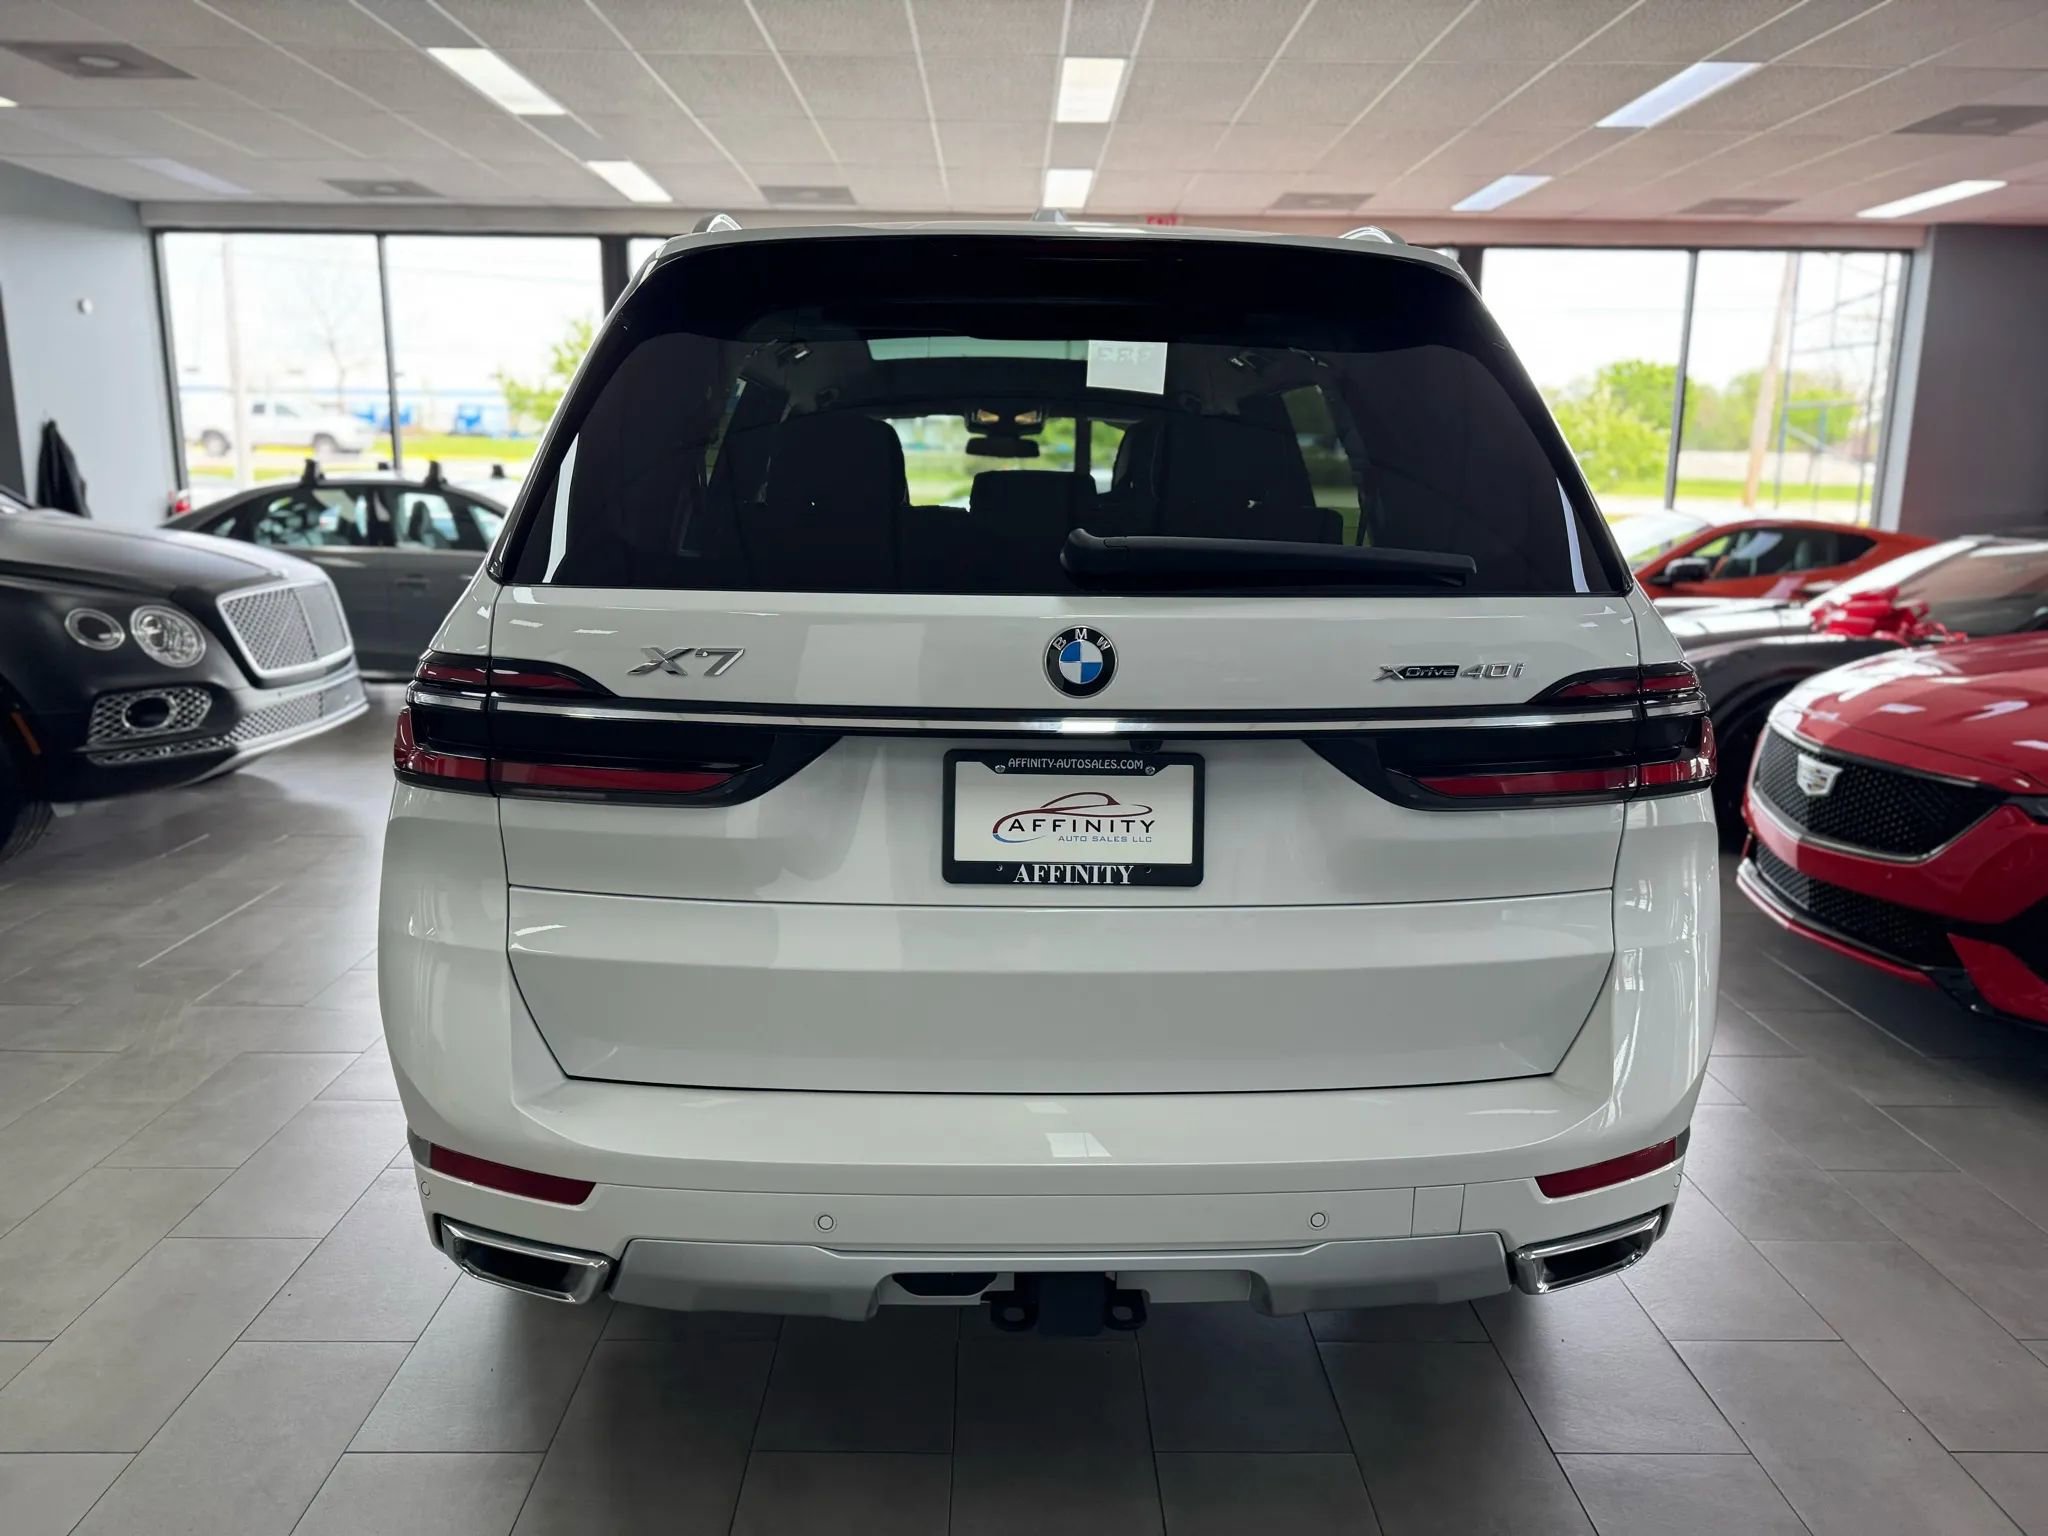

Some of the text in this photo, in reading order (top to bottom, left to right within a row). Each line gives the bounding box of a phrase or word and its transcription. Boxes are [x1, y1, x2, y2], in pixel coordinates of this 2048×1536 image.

[1052, 628, 1111, 651] BMW
[627, 647, 745, 676] X7
[1460, 662, 1525, 680] 40i
[1008, 758, 1143, 770] AFFINITY-AUTOSALES.COM
[1008, 818, 1155, 833] AFFINITY
[1013, 864, 1134, 884] AFFINITY
